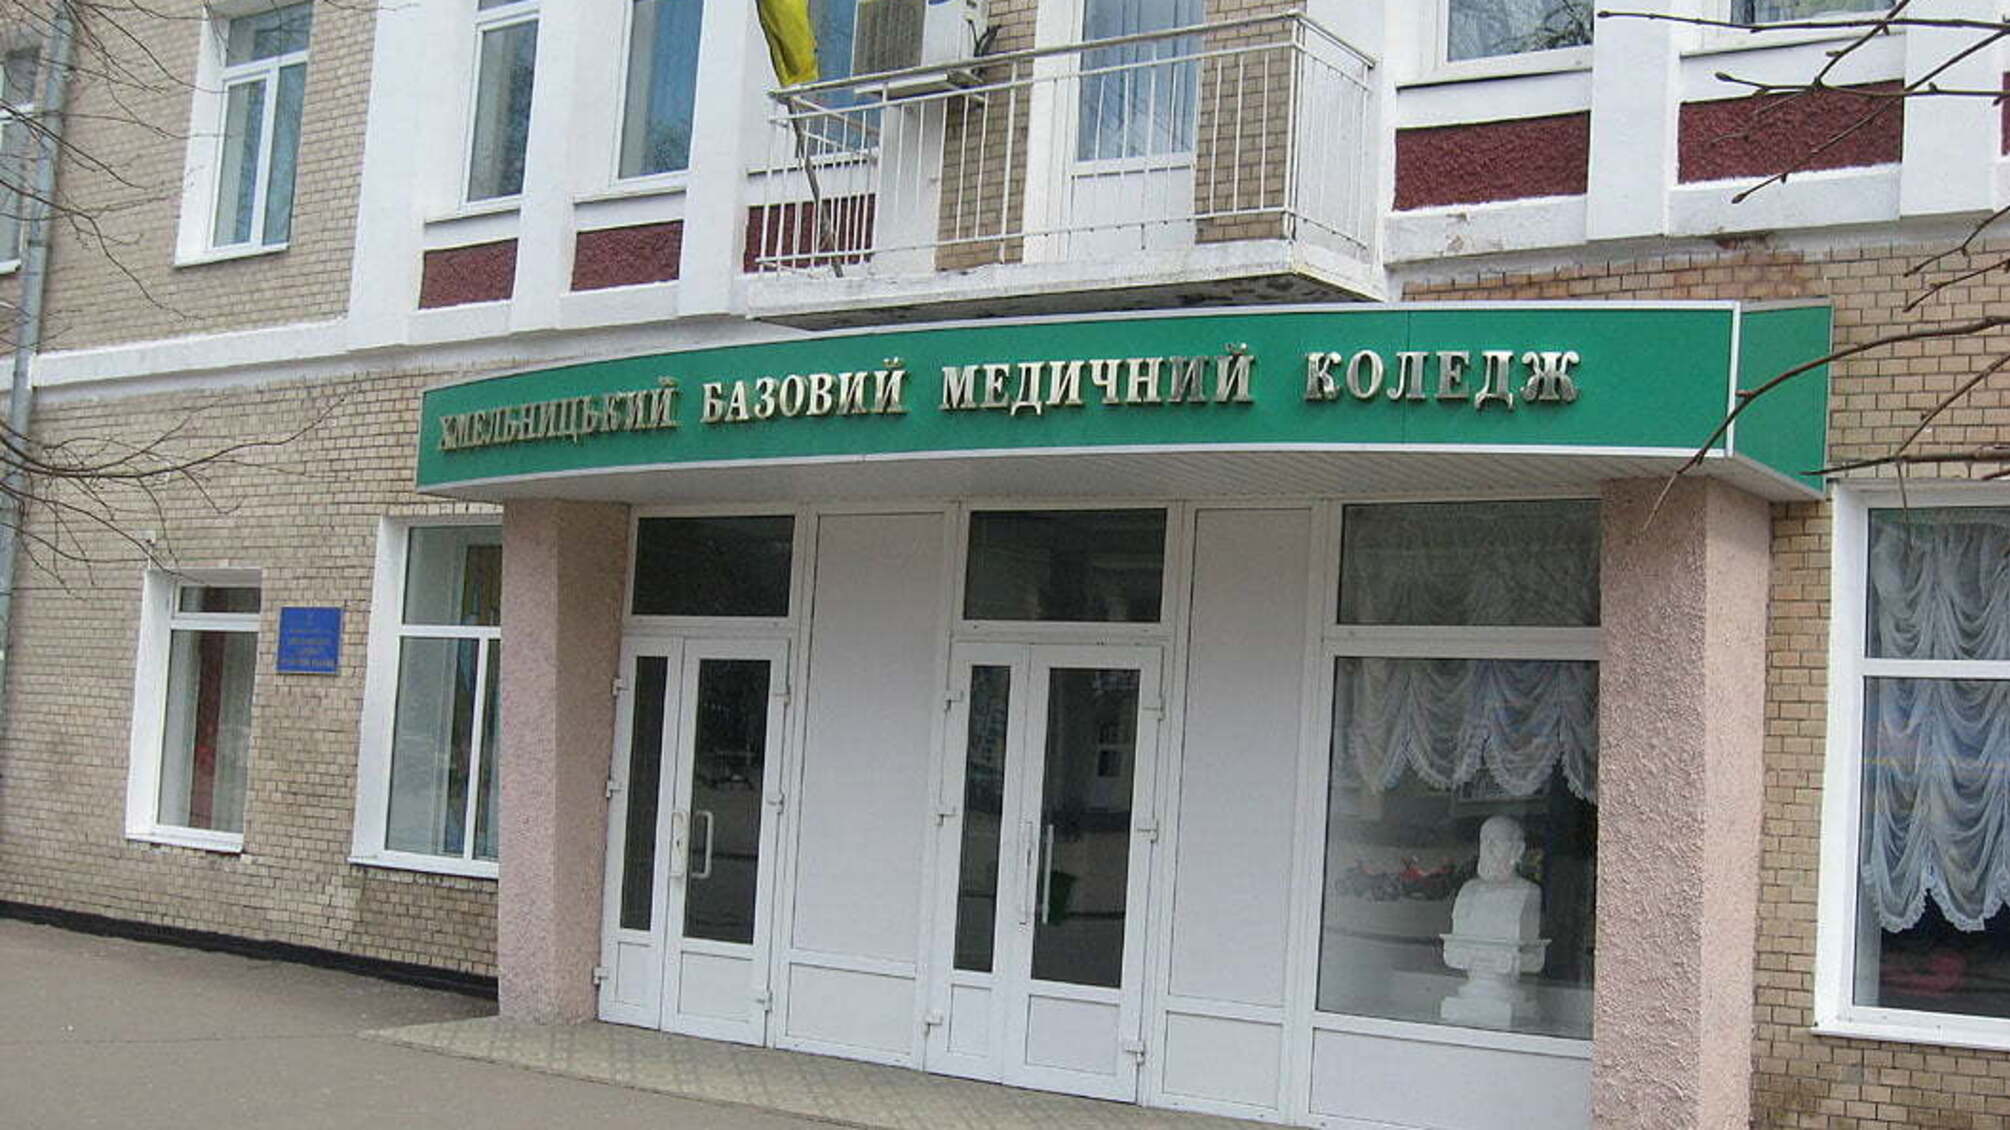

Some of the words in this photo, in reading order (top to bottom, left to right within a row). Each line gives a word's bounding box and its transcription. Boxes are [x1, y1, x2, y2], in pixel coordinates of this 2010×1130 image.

[439, 376, 679, 451] ХМЕЛЬНИЦЬКИЙ
[701, 357, 907, 424] БАЗОВИЙ
[940, 342, 1255, 416] МЕДИЧНИЙ
[1304, 350, 1581, 408] КОЛЕДЖ
